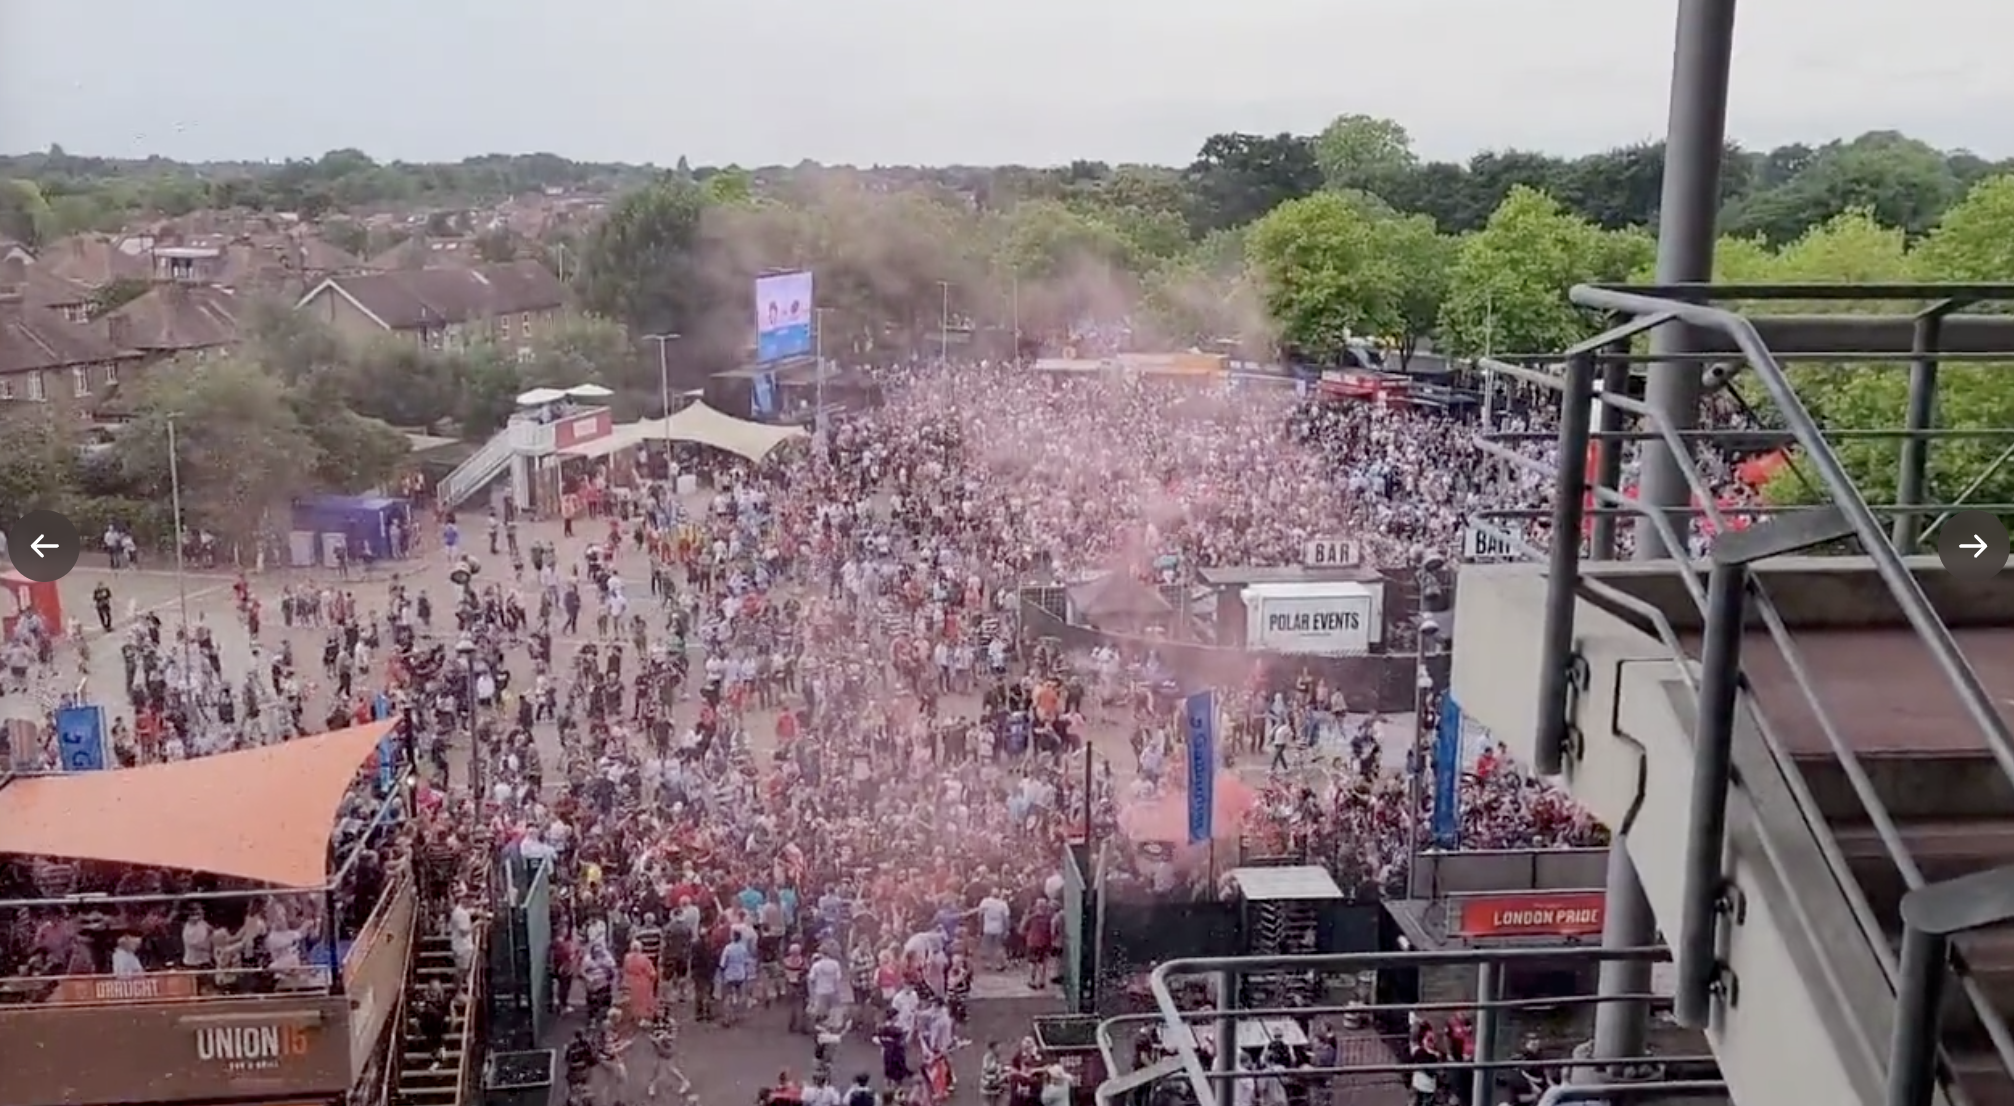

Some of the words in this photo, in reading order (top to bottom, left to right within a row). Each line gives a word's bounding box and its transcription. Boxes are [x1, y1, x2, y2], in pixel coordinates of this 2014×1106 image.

[1315, 543, 1350, 563] BAR
[1269, 613, 1310, 631] POLAR
[1313, 612, 1359, 630] EVENTS
[1493, 910, 1554, 926] LONDON
[1556, 909, 1600, 924] PRIDE
[95, 979, 159, 999] DRAUGHT
